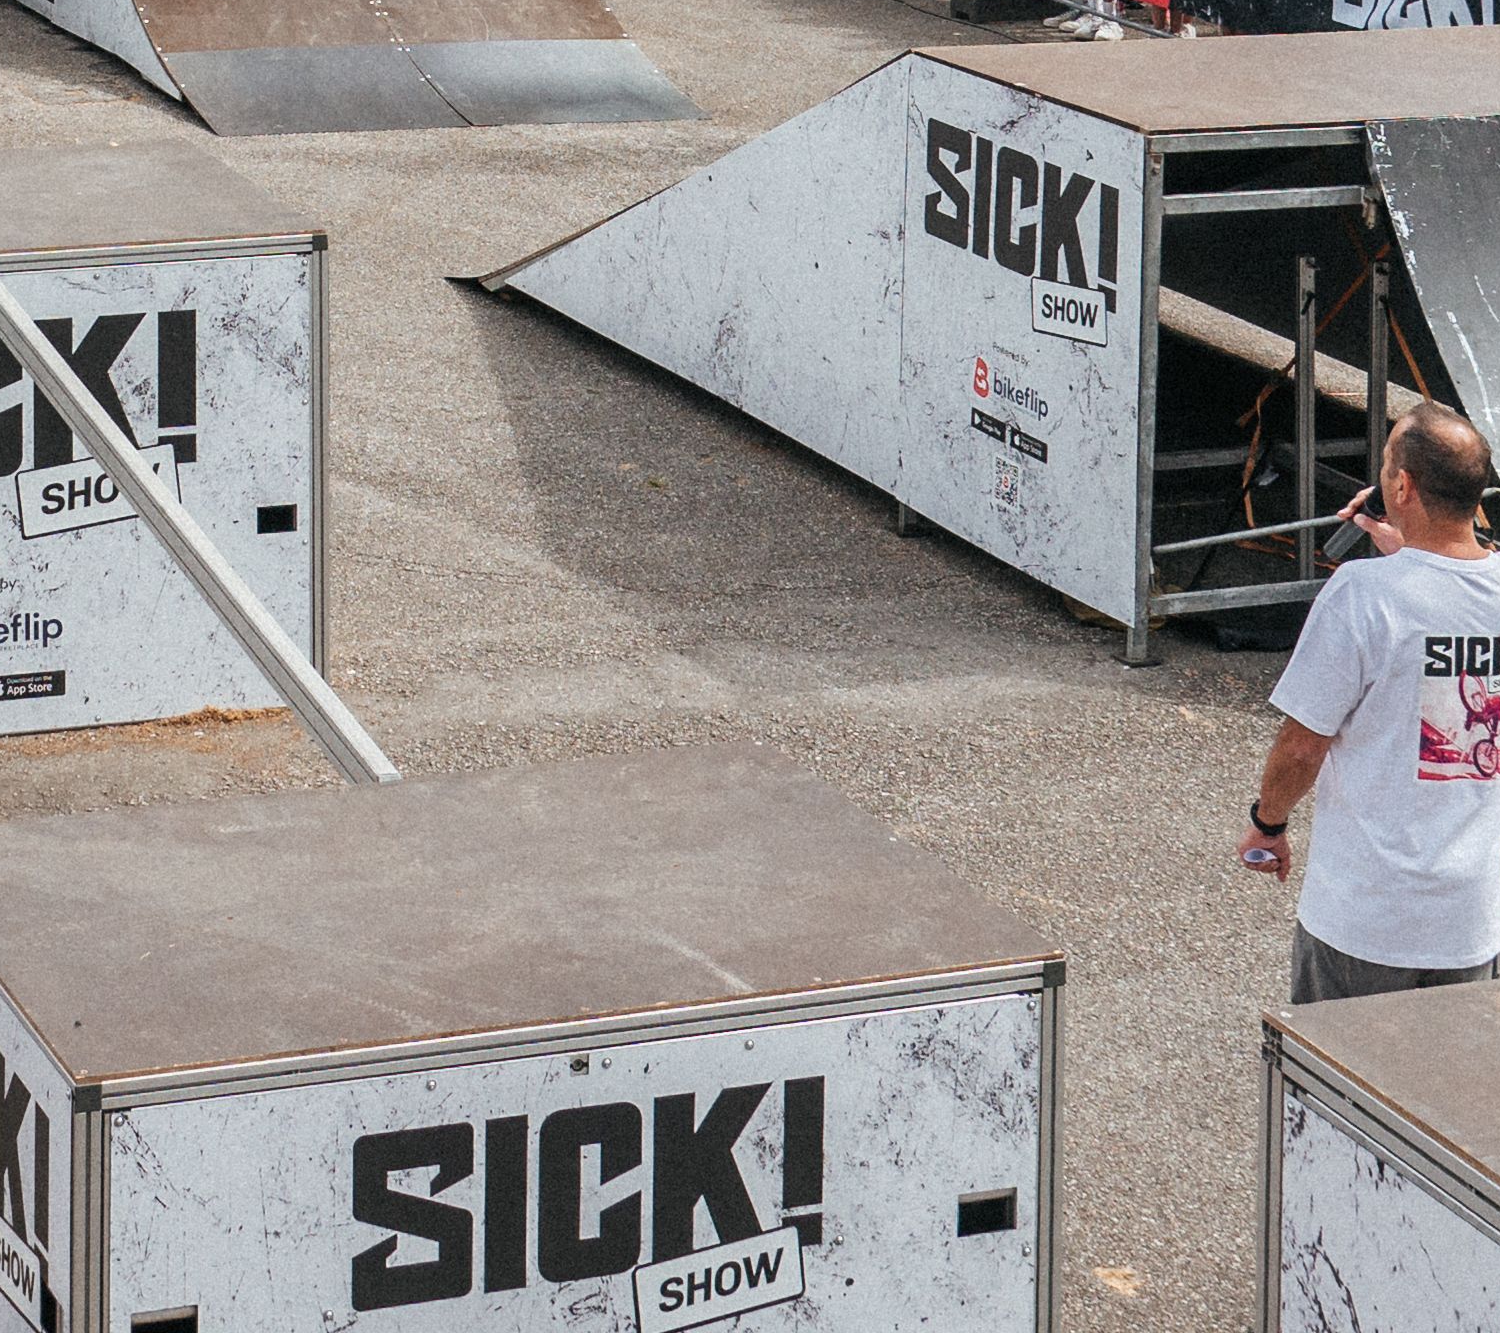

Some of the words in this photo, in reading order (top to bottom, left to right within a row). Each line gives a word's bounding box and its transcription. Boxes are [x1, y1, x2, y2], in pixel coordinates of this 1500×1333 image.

[924, 117, 1119, 314] SICK!
[1041, 294, 1099, 328] SHOW
[993, 371, 1049, 421] bikeflip
[6, 685, 26, 697] App
[28, 681, 53, 694] Store
[352, 1075, 825, 1312] SICK!
[658, 1246, 785, 1312] SHOW
